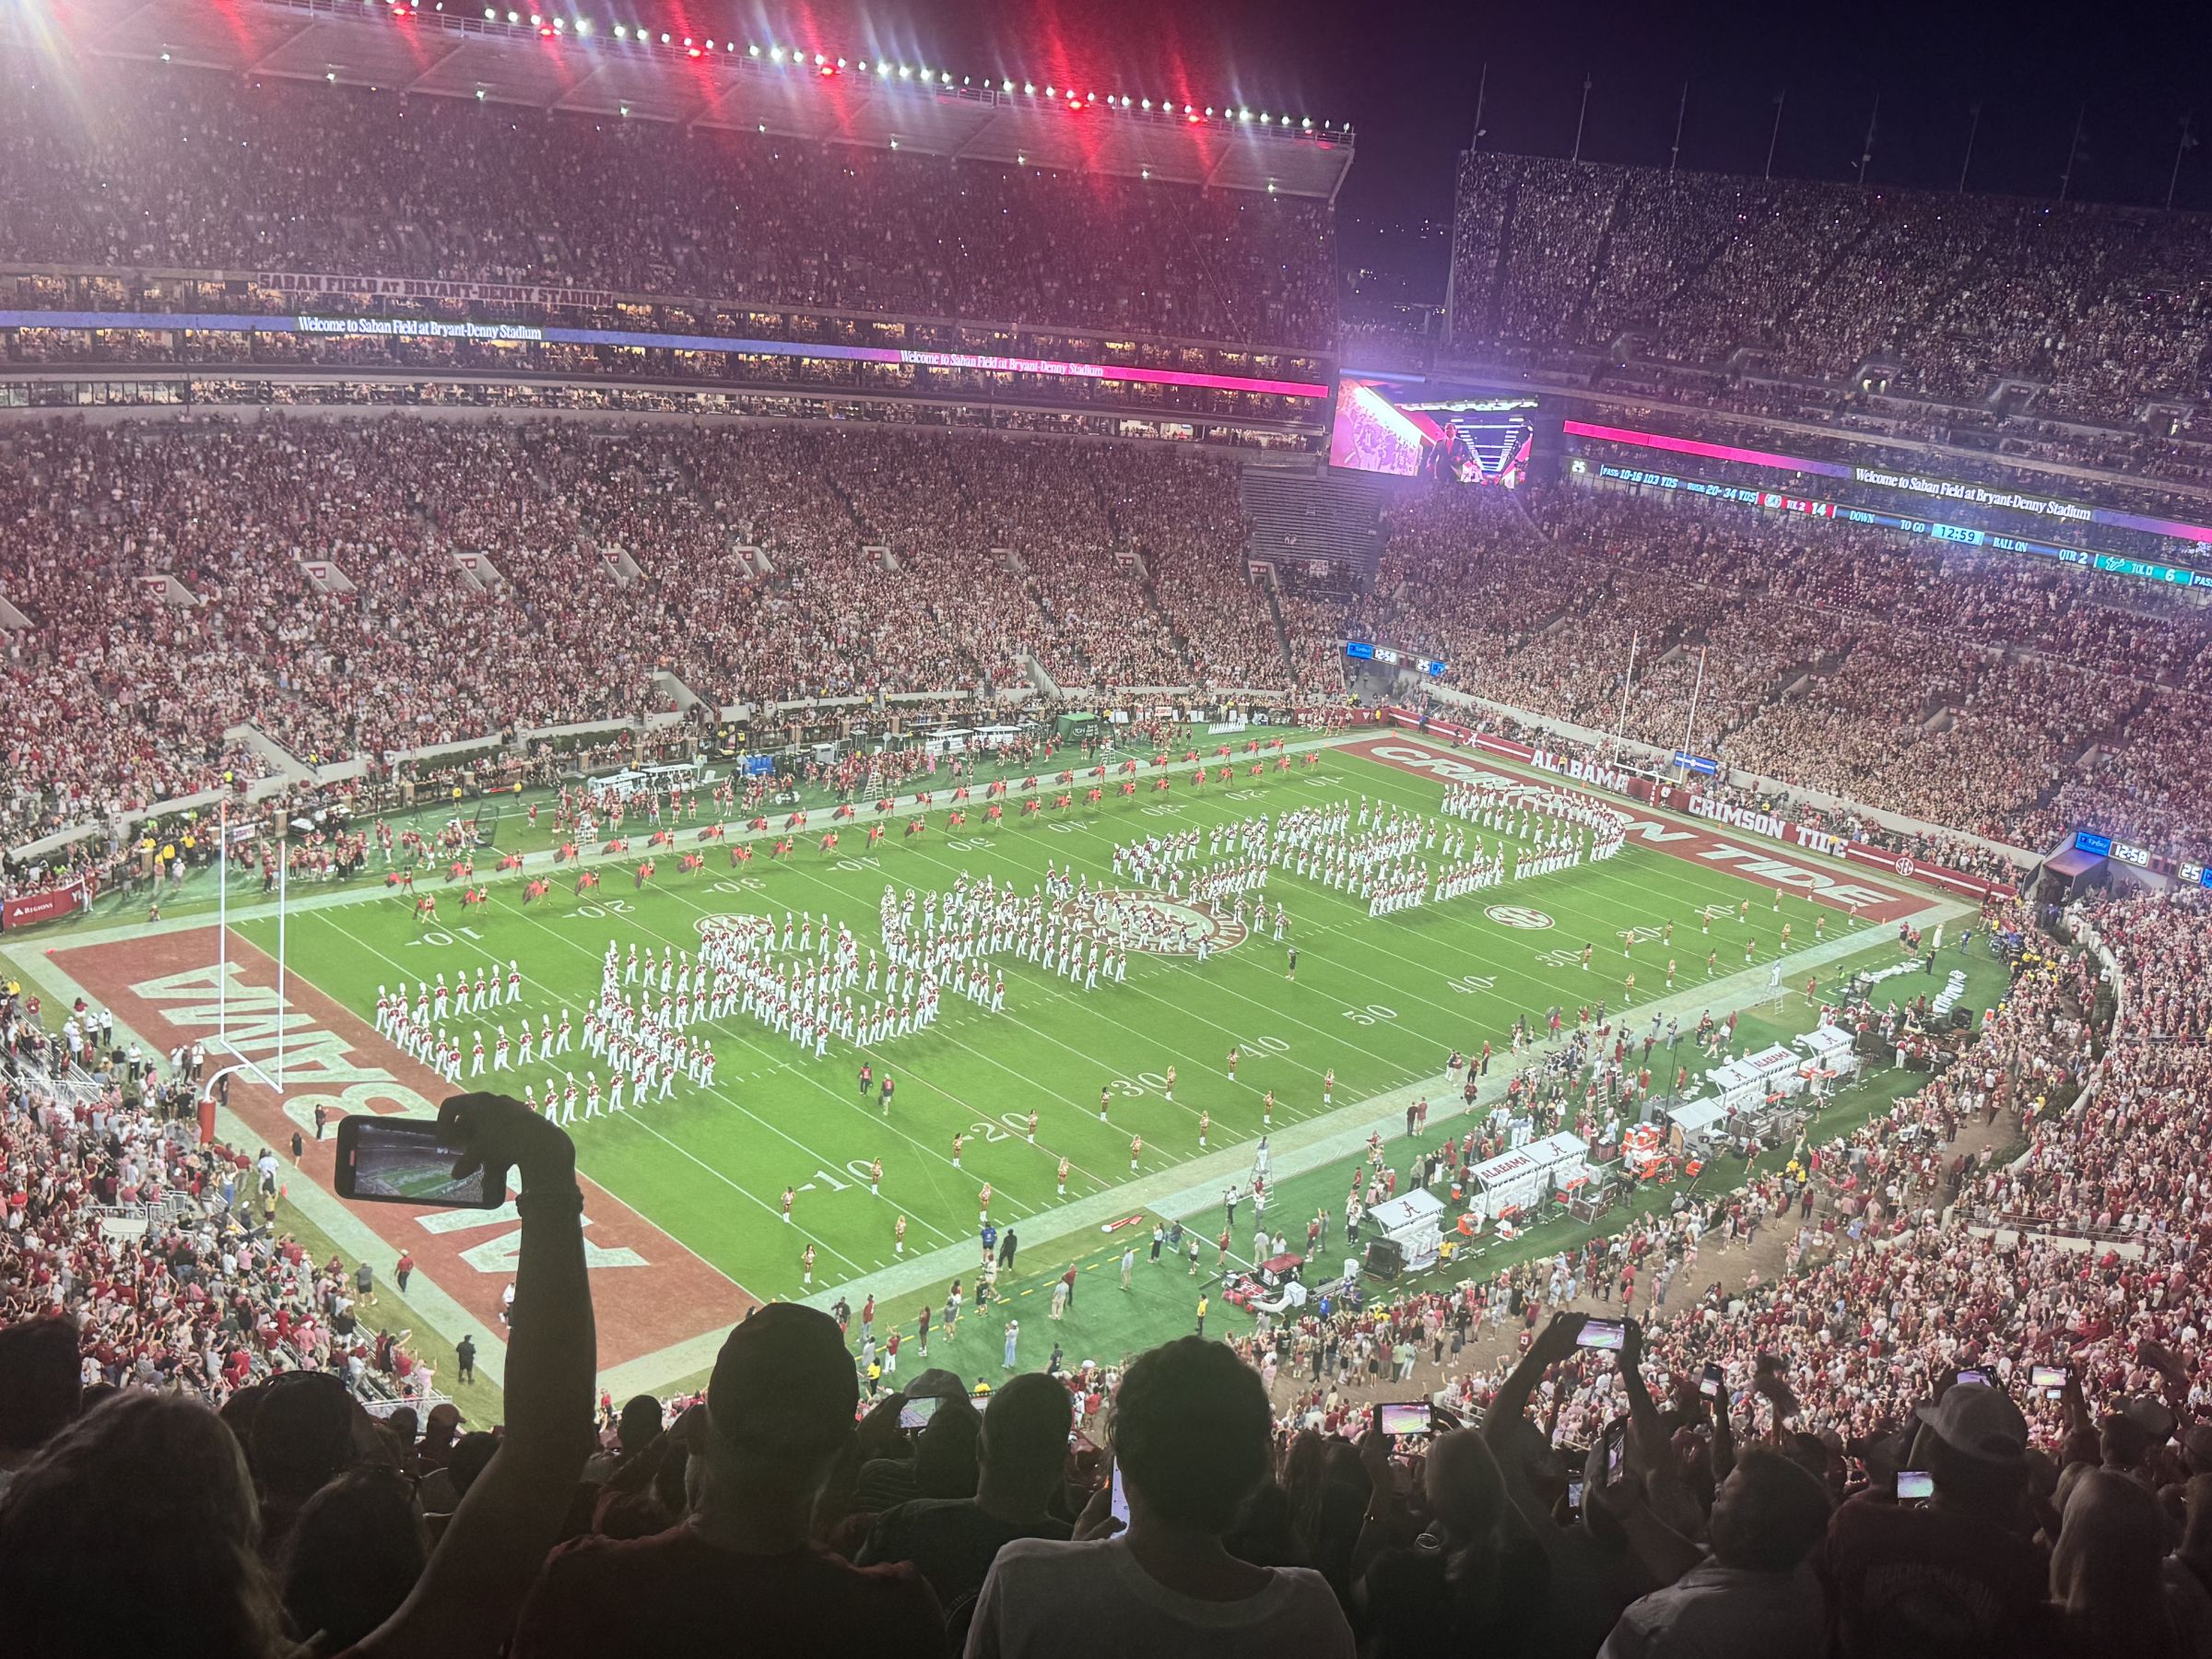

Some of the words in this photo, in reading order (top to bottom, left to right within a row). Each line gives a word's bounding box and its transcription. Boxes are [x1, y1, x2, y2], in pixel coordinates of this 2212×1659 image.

[259, 274, 321, 291] SABAN
[326, 276, 378, 293] FIELD
[381, 280, 400, 294] AT
[404, 280, 535, 302] BRYANT-DENNY
[538, 289, 613, 307] STADIUM
[298, 316, 346, 332] Welcome
[347, 319, 358, 332] to
[358, 318, 392, 334] Saban
[392, 320, 418, 335] Field
[418, 322, 429, 335] at
[429, 322, 501, 340] Bryant-Denny
[500, 324, 542, 340] Stadium
[900, 349, 939, 365] Welcome
[940, 353, 949, 366] to
[950, 354, 976, 368] Saban
[977, 356, 997, 370] Field
[997, 359, 1007, 371] at
[1008, 358, 1067, 375] Bryant-Denny
[1068, 361, 1103, 377] Stadium
[1661, 477, 1678, 488] YDS
[1737, 490, 1757, 503] YDS
[1855, 467, 1898, 488] Welcome
[1899, 477, 1909, 489] to
[1908, 477, 1940, 494] Saban
[1940, 482, 1965, 499] Field
[1965, 488, 1976, 500] at
[1976, 488, 2047, 513] Bryant-Denny
[2046, 500, 2092, 521] Stadium
[1811, 502, 1827, 516] 14
[1849, 510, 1876, 524] DOWN
[1900, 519, 1912, 531] TO
[1912, 522, 1925, 534] GO
[1940, 526, 1976, 542] 12:59
[1992, 536, 2014, 550] BALL
[2015, 540, 2029, 553] ON
[2058, 548, 2077, 562] QTR
[2077, 552, 2088, 565] 2
[2165, 569, 2175, 582] 6
[1688, 794, 1786, 841] CRIMSON
[947, 837, 996, 852] 50
[2114, 843, 2148, 865] 12:58
[1697, 843, 1900, 907] TIDE
[1896, 861, 1913, 875] SEC
[2181, 865, 2201, 880] 25
[576, 900, 636, 919] 20
[1535, 949, 1582, 968] 30
[1446, 975, 1495, 994] 40
[1341, 1004, 1397, 1026] 50
[1239, 1036, 1290, 1059] 40
[1753, 1050, 1793, 1068] ALABAMA
[1111, 1073, 1169, 1097] 30
[971, 1112, 1038, 1143] 20
[813, 1159, 884, 1192] 10
[1480, 1155, 1532, 1181] ALABAMA
[1398, 1200, 1421, 1218] A
